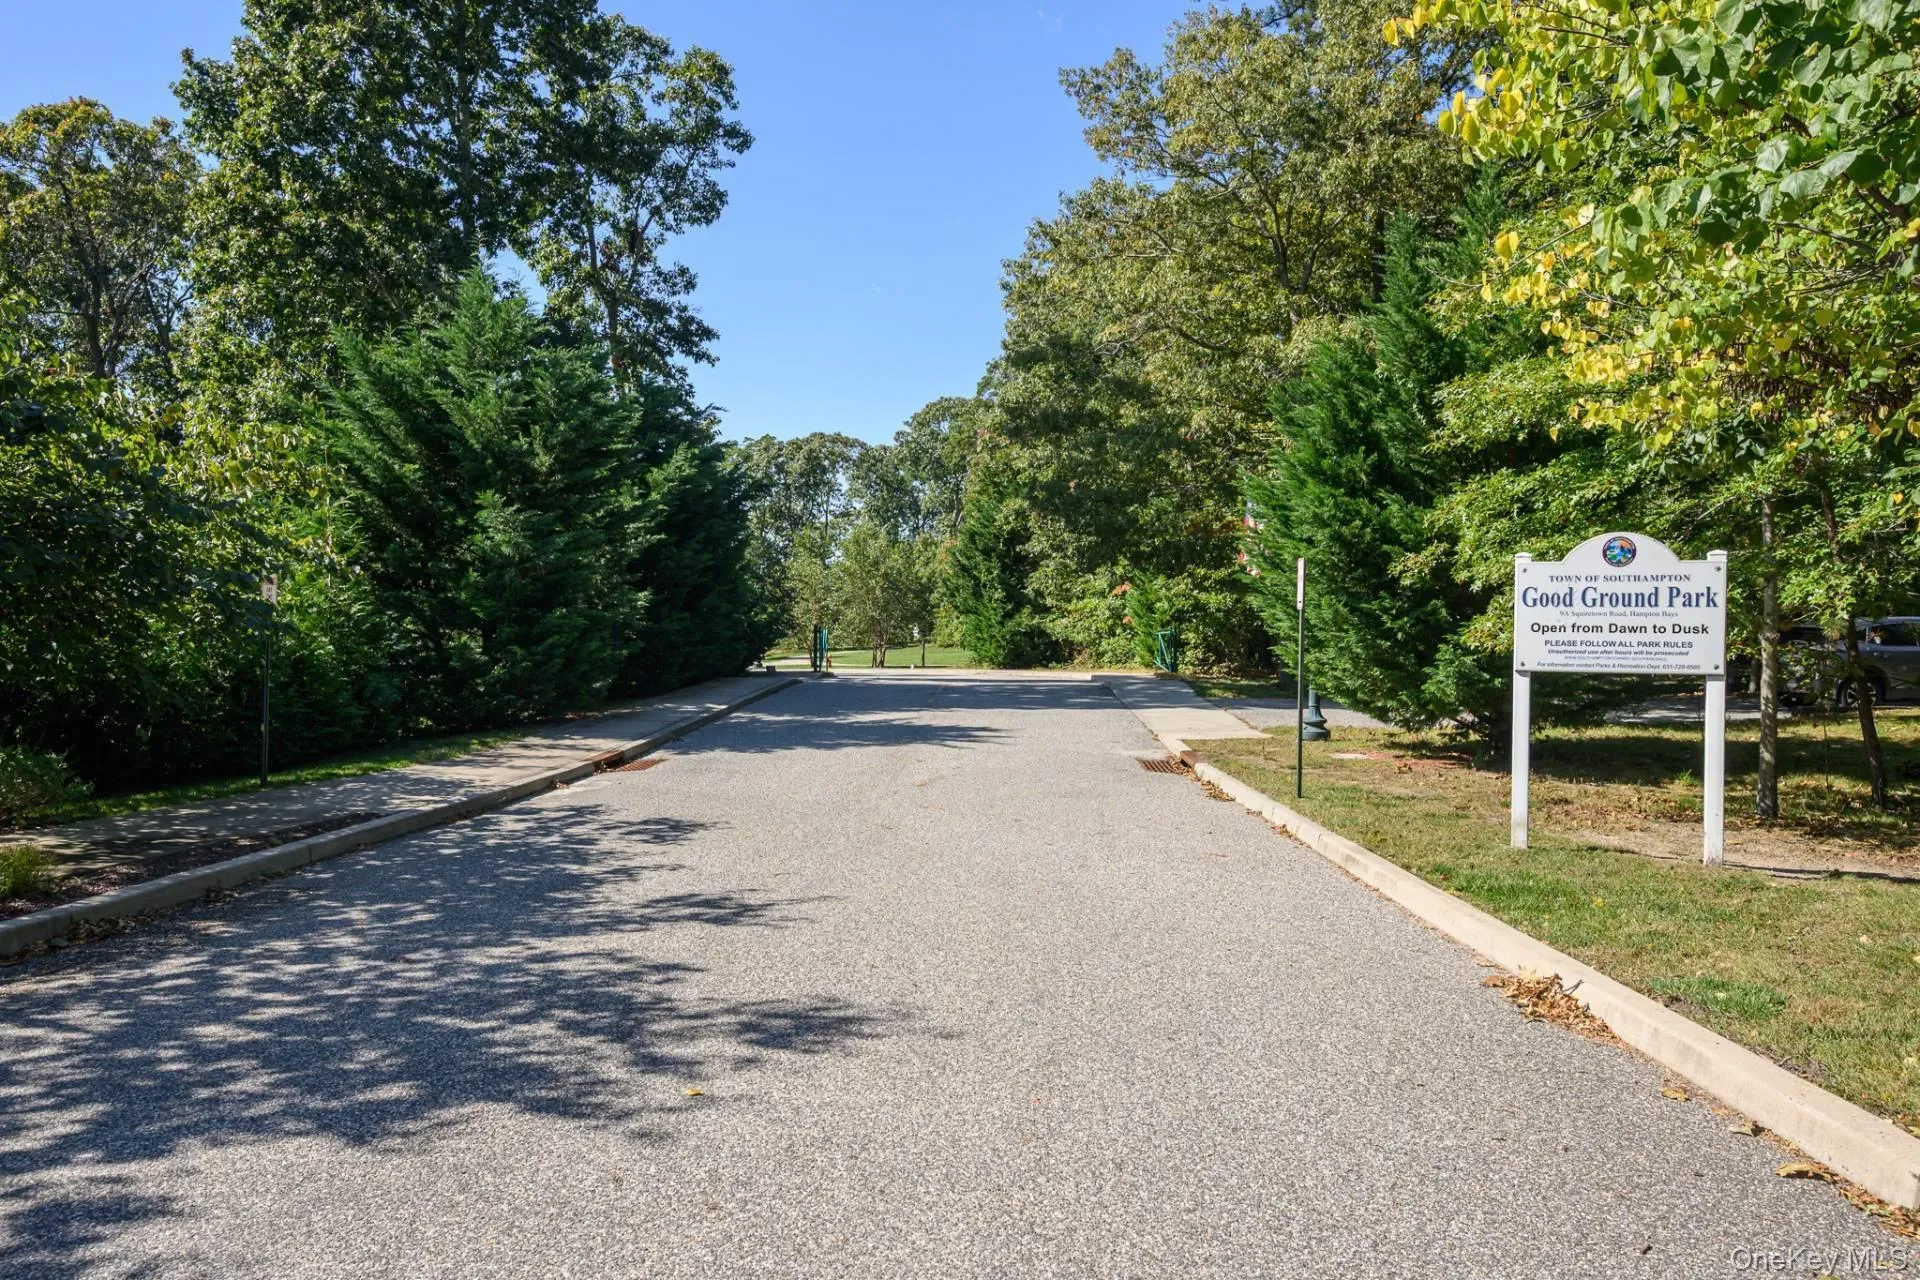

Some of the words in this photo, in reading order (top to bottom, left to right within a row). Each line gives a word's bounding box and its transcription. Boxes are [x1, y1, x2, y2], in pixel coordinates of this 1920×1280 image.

[1549, 575, 1581, 583] TOWN
[1603, 574, 1691, 582] SOUTHAMPTON
[1522, 586, 1573, 608] Good
[1581, 586, 1659, 608] Ground
[1667, 586, 1719, 608] Park
[1531, 622, 1567, 635] Open
[1572, 623, 1604, 633] from
[1608, 623, 1648, 634] Dawn
[1653, 624, 1667, 634] to
[1672, 624, 1710, 634] Dusk
